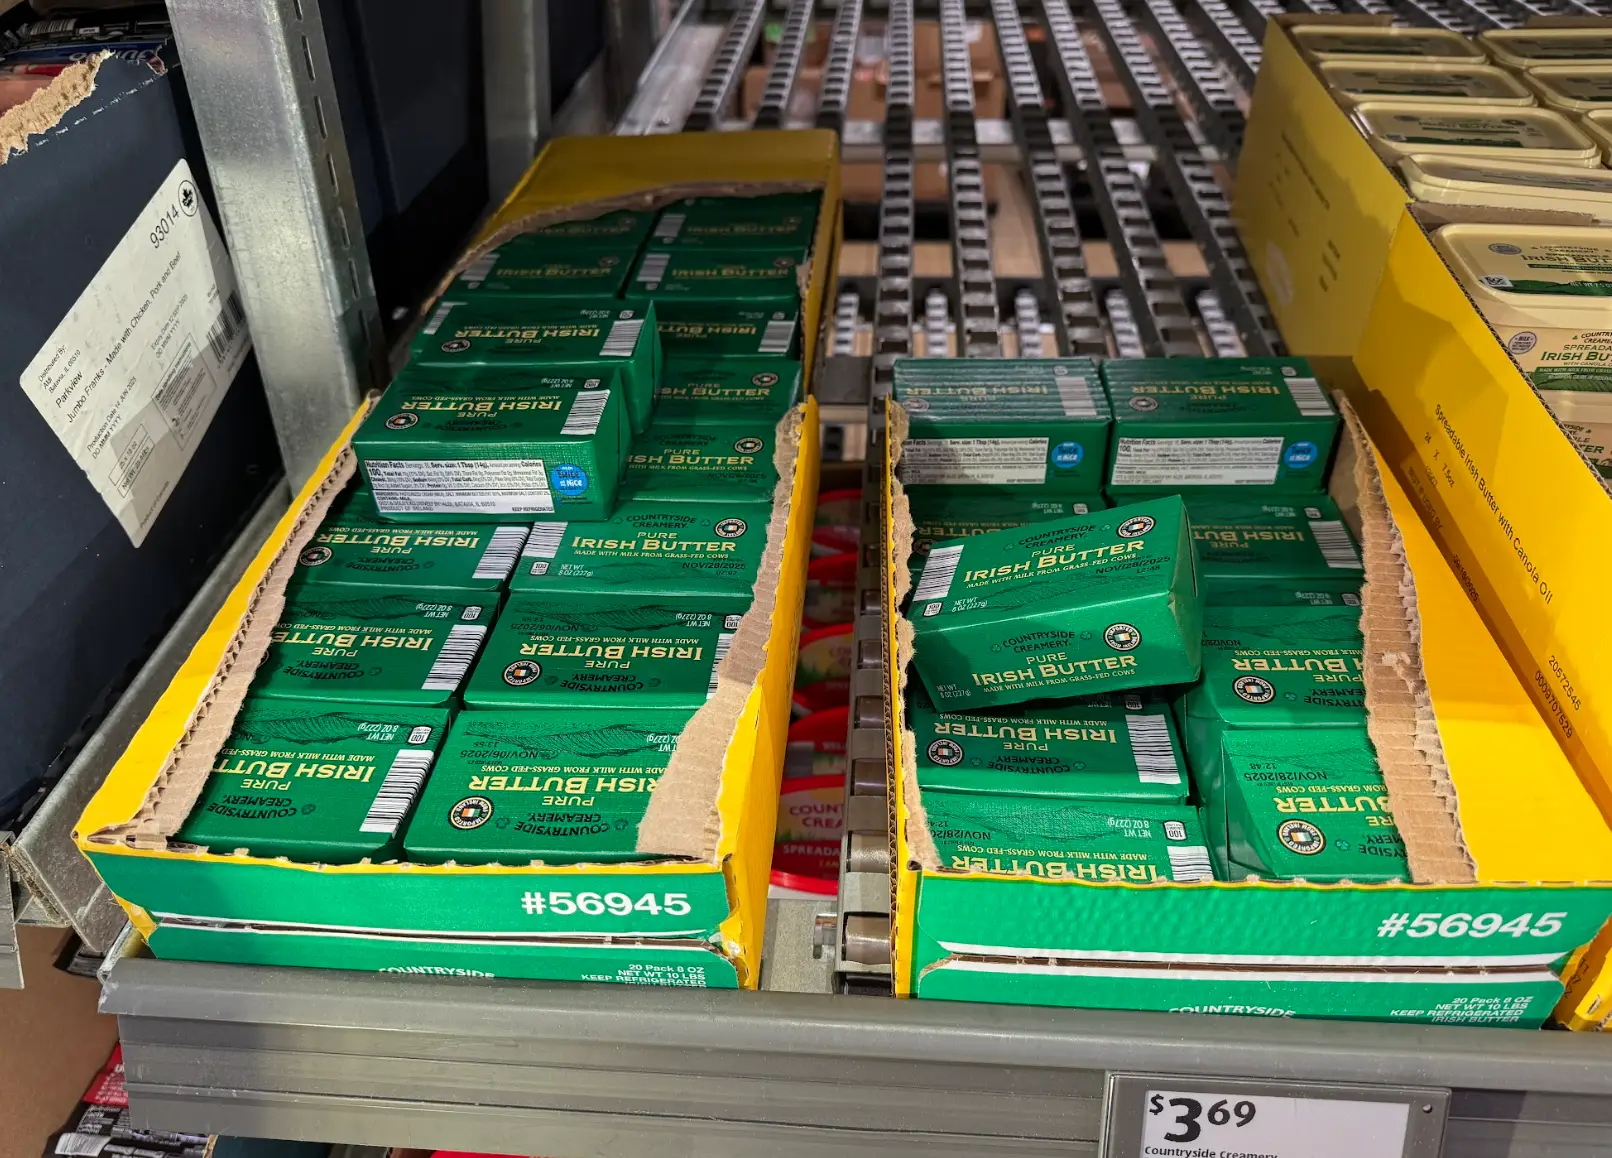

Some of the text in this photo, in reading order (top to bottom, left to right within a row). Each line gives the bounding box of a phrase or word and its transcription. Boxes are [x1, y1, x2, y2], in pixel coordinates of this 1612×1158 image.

[150, 204, 180, 249] 93014
[455, 329, 600, 340] IRISH BUTTER
[657, 324, 757, 335] IRISH BUTT
[65, 394, 87, 424] Jumbo
[84, 368, 106, 396] Franks
[106, 340, 122, 364] Made
[120, 326, 133, 344] with
[150, 281, 162, 300] Pork
[161, 268, 172, 283] and
[169, 250, 182, 270] Beef
[1541, 352, 1583, 360] IRISH
[56, 371, 84, 408] Parkview
[904, 386, 997, 396] BUTTER
[1131, 384, 1280, 395] IRISH BUTTER
[400, 401, 562, 411] IRISH BUTTER
[86, 422, 109, 452] Production
[106, 408, 118, 424] Date
[669, 456, 754, 465] BUTTER
[1435, 404, 1554, 605] Spreadable Irish Butter with Canola Oil
[626, 514, 696, 524] COUNTRYSIDE
[317, 534, 480, 549] IRISH BUTTER
[1018, 524, 1096, 546] COUNTRYSIDE
[1194, 531, 1305, 541] IRISH BUT
[572, 537, 736, 552] IRISH BUTTER
[1031, 544, 1075, 558] PURE
[347, 562, 420, 573] COUNTRYSIDE
[682, 562, 747, 570] NOV/28/2025
[963, 539, 1145, 583] IRISH BUTTER
[1095, 556, 1171, 575] NOV/28/2025
[510, 623, 579, 632] NOV/06/2025
[270, 632, 436, 651] IRISH BUTTE
[1002, 631, 1075, 648] COUNTRYSIDE
[312, 647, 358, 657] PURE
[519, 643, 704, 662] IRISH BUTTER
[1026, 652, 1068, 665] PURE
[584, 661, 631, 669] PURE
[971, 655, 1137, 686] IRISH BUTTER
[1230, 658, 1352, 672] BUTTER
[283, 665, 365, 680] COUNTRYSIDE
[1312, 674, 1363, 683] PURE
[560, 680, 644, 693] COUNTRYSIDE
[983, 668, 1136, 693] MADE WITH MILK FROM GRASS-FED COWS
[357, 722, 380, 732] (227g)
[934, 722, 1116, 744] IRISH BUTTER
[1003, 742, 1048, 751] PURE
[460, 749, 538, 759] NOV/06/2025
[996, 755, 1060, 765] CREAMERY
[211, 759, 376, 783] IRISH BUTT
[987, 761, 1071, 774] COUNTRYSIDE
[1244, 771, 1328, 781] NOV/28/2025
[240, 779, 292, 791] PURE
[468, 775, 661, 795] RISH BUTTER
[541, 796, 595, 806] PURE
[207, 802, 298, 820] COUNTRYSIDE
[513, 822, 610, 837] COUNTRYSIDE
[783, 844, 840, 856] SPREADA
[520, 891, 692, 916] #56945
[1376, 911, 1568, 939] #56945
[616, 976, 706, 984] REFRIGERATED
[1144, 1146, 1216, 1158] Countryside
